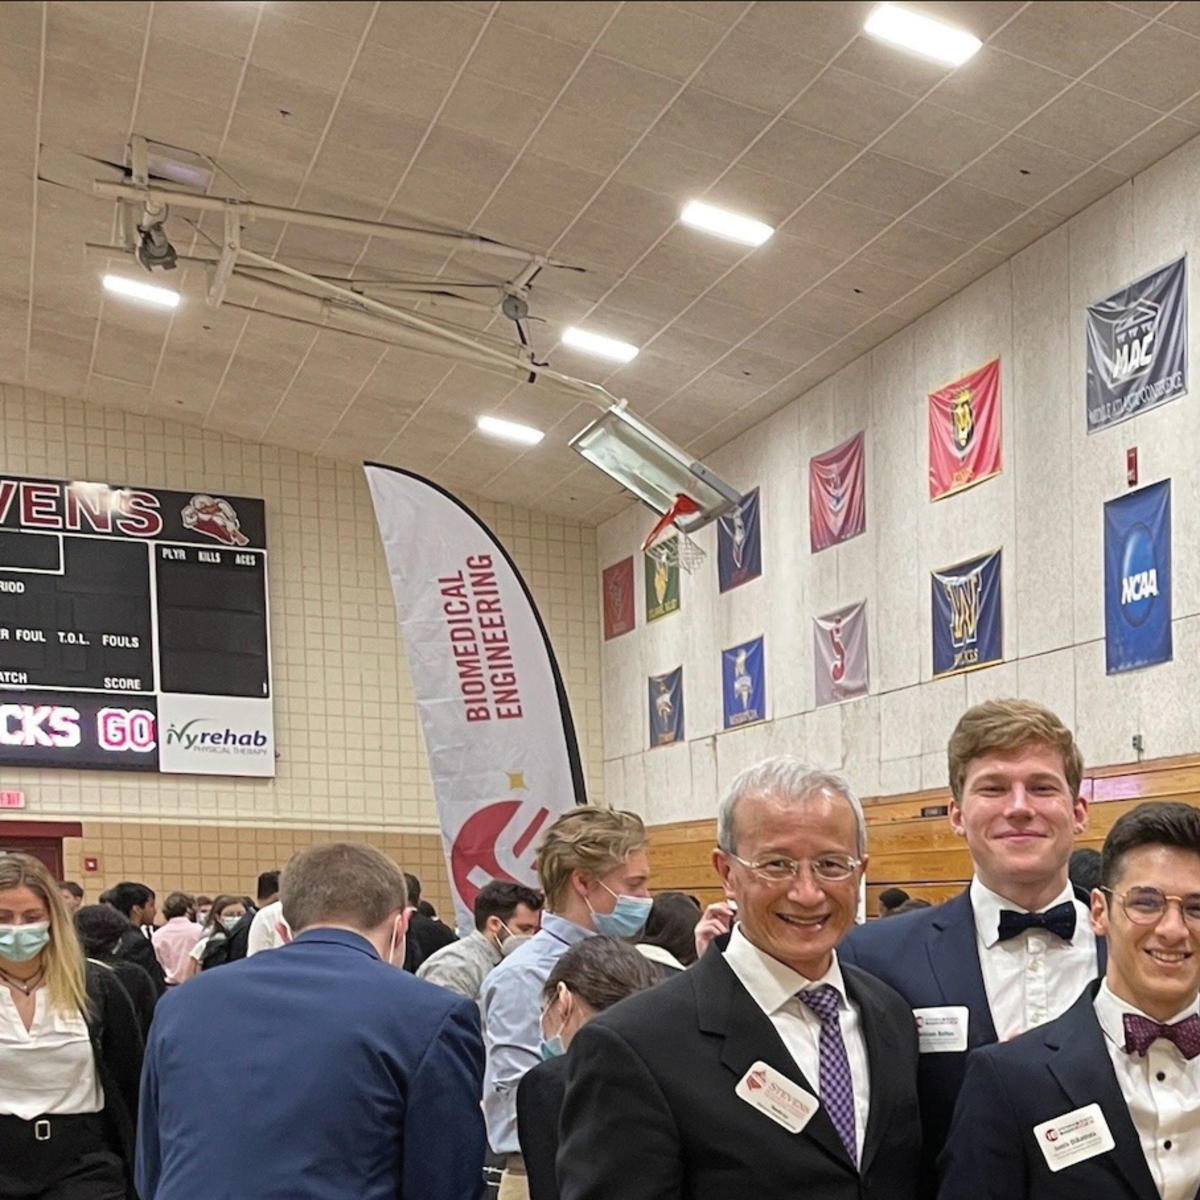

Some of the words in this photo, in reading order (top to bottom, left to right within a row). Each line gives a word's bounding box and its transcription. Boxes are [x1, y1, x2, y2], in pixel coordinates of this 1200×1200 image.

[1112, 331, 1155, 379] MAC
[162, 547, 186, 560] PLYR
[198, 550, 221, 564] KILLS
[235, 553, 256, 566] ACES
[1121, 568, 1158, 605] NCAA
[15, 629, 46, 642] FOUL
[57, 631, 90, 645] T.O.L.
[102, 634, 140, 648] FOULS
[466, 555, 523, 719] ENGINEERING
[438, 570, 491, 722] BIOMEDICAL
[103, 677, 141, 690] SCORE
[97, 707, 156, 752] GO
